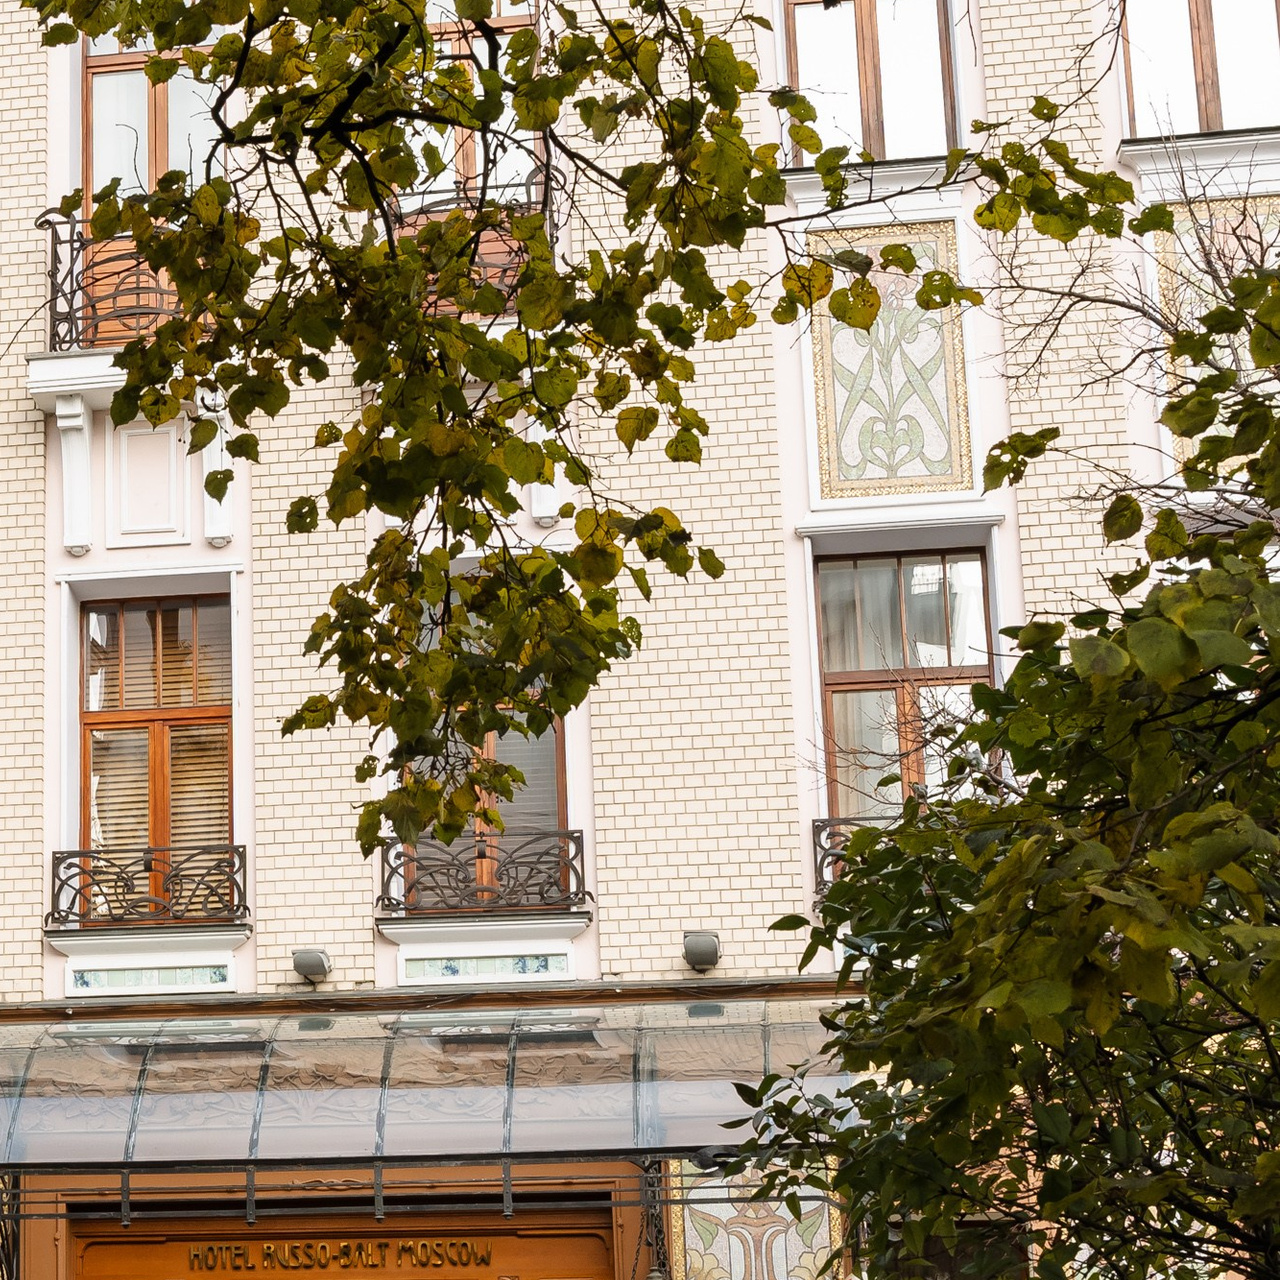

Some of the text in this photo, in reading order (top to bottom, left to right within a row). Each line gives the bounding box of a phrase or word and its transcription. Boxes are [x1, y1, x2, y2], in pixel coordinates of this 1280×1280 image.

[189, 1240, 493, 1270] HOTEL RUSSO-BALT MOSCOW
